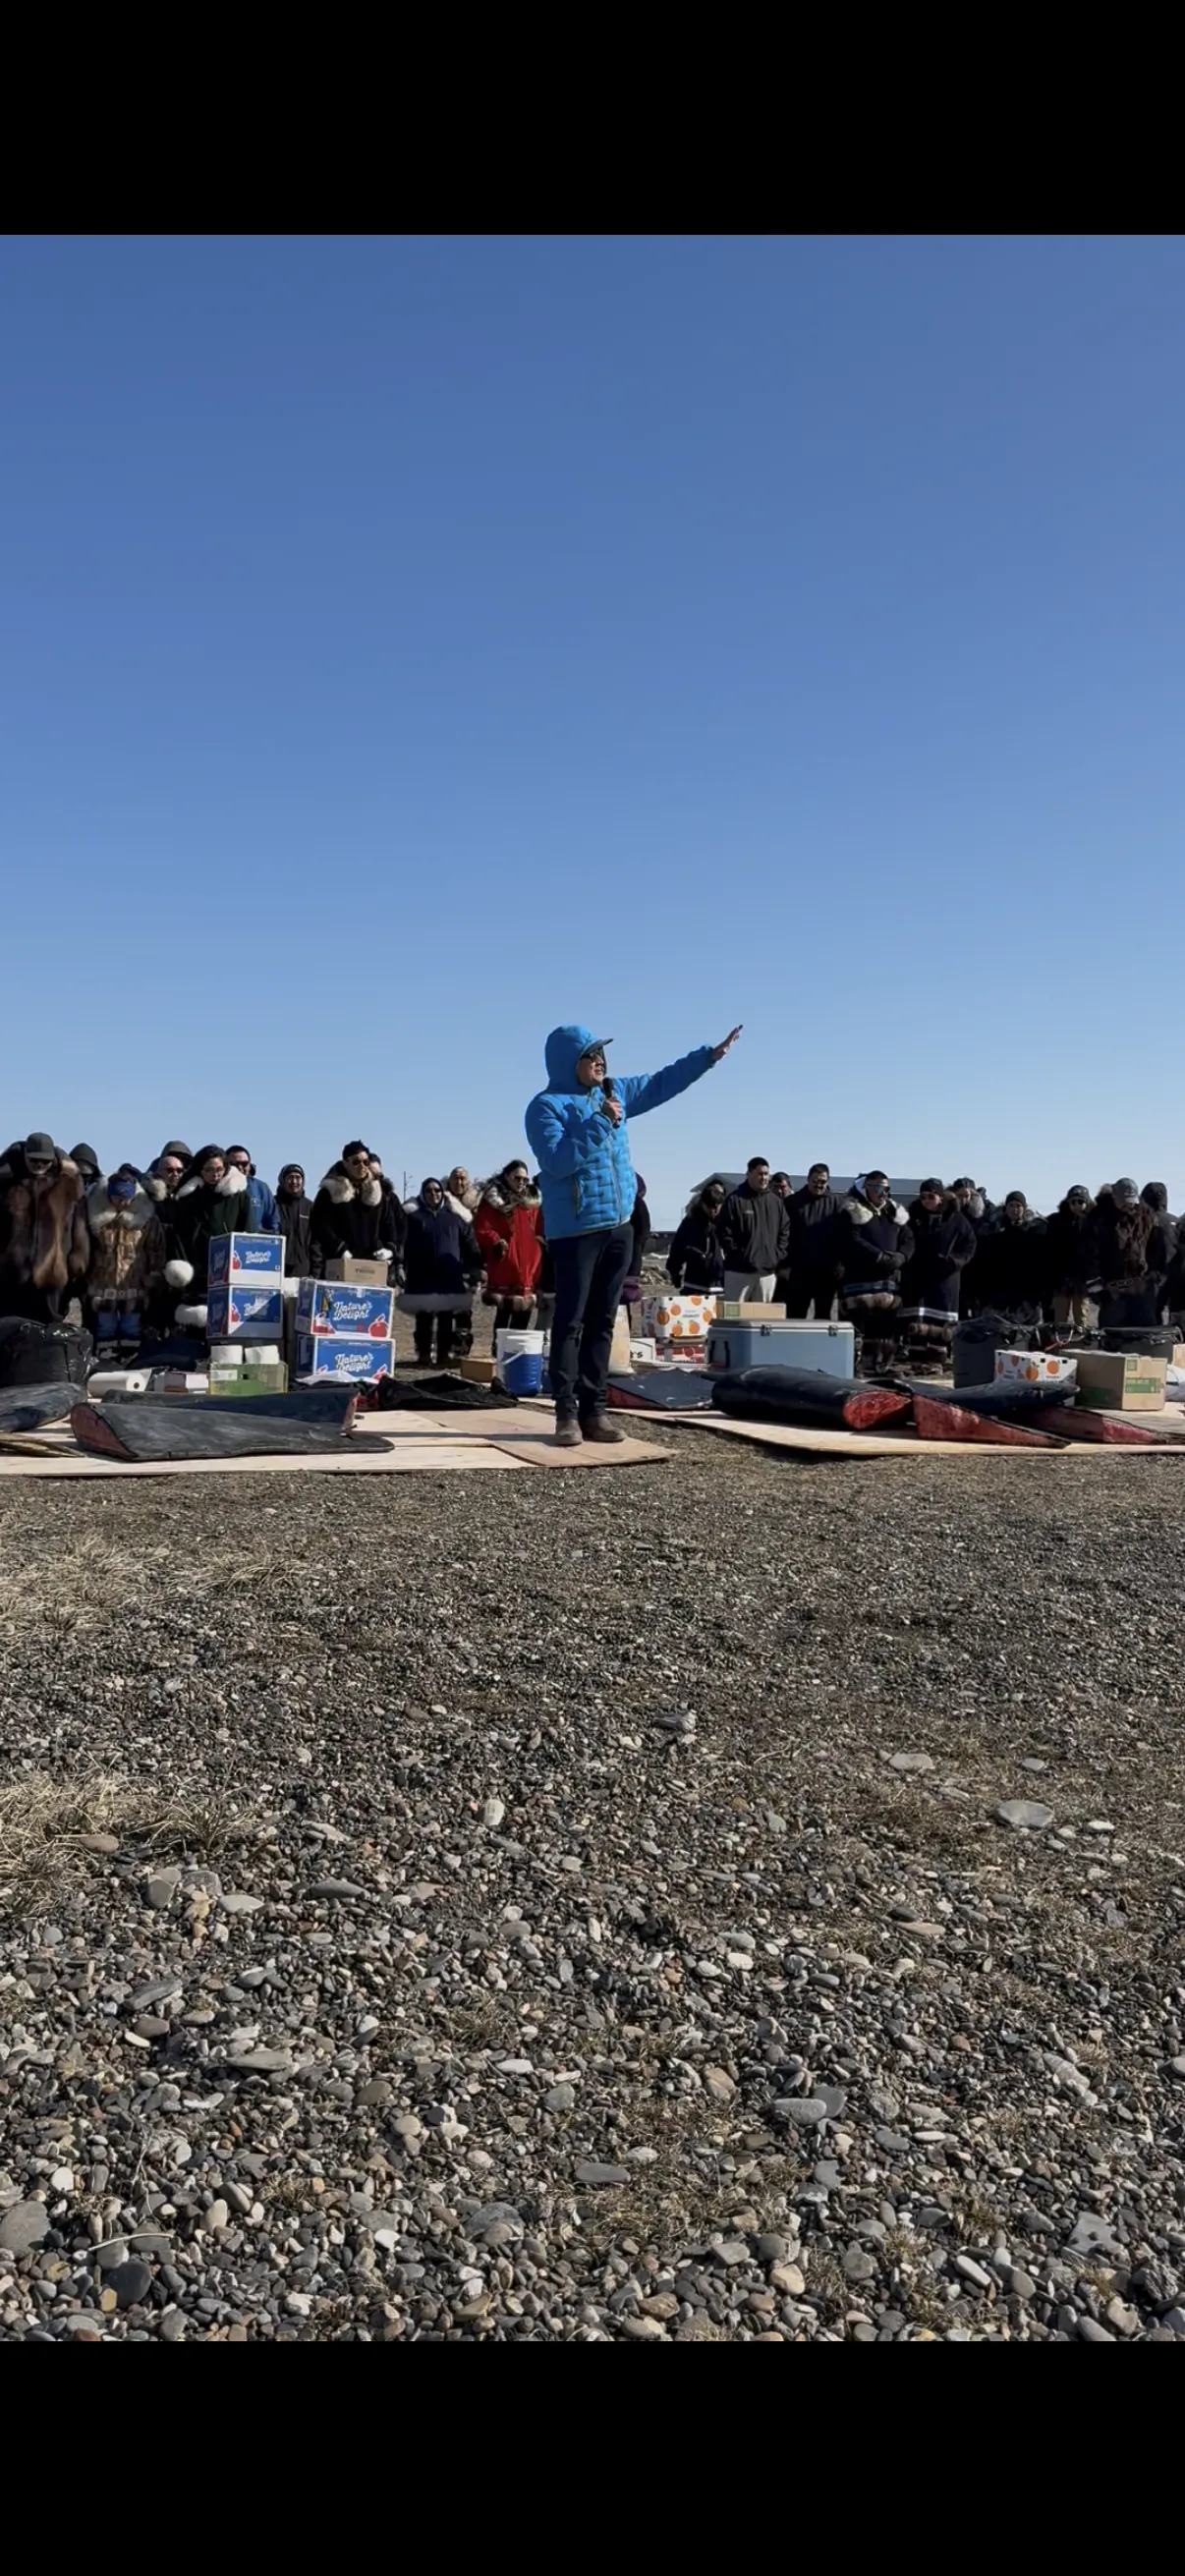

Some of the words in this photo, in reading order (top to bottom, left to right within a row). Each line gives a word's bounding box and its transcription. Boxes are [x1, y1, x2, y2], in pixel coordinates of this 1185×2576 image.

[334, 1301, 372, 1313] Nature's
[333, 1310, 369, 1321] Delight
[335, 1352, 374, 1363] Nature's
